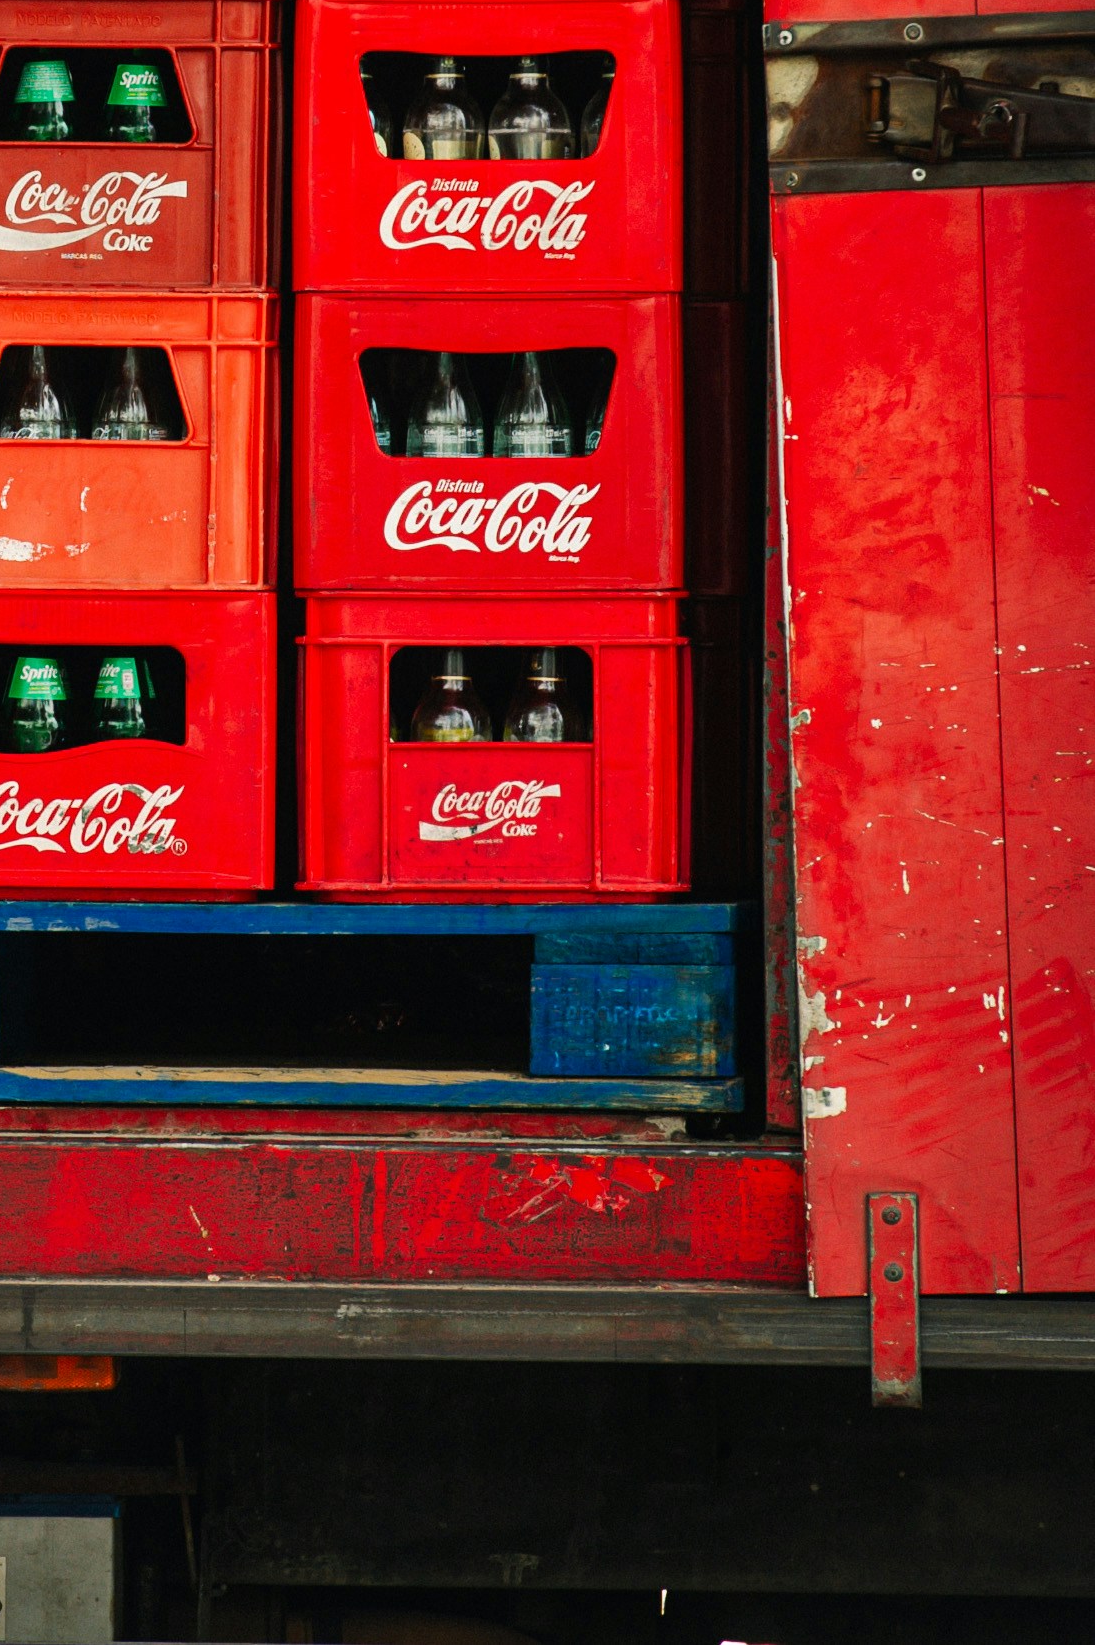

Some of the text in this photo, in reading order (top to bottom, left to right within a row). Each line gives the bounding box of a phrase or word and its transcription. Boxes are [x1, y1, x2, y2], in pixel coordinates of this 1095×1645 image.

[120, 70, 158, 88] Sprite
[431, 178, 479, 193] Disfruta
[6, 170, 168, 226] Coca-Cola
[379, 180, 596, 251] Coca-Cola
[102, 229, 154, 252] Coke
[13, 311, 159, 328] MODELO PATENTADO
[436, 478, 484, 493] Disfruta
[383, 480, 601, 553] Coca-Cola
[20, 665, 58, 683] Sprite
[432, 780, 544, 822] Coca-Cola
[501, 820, 537, 838] Coke
